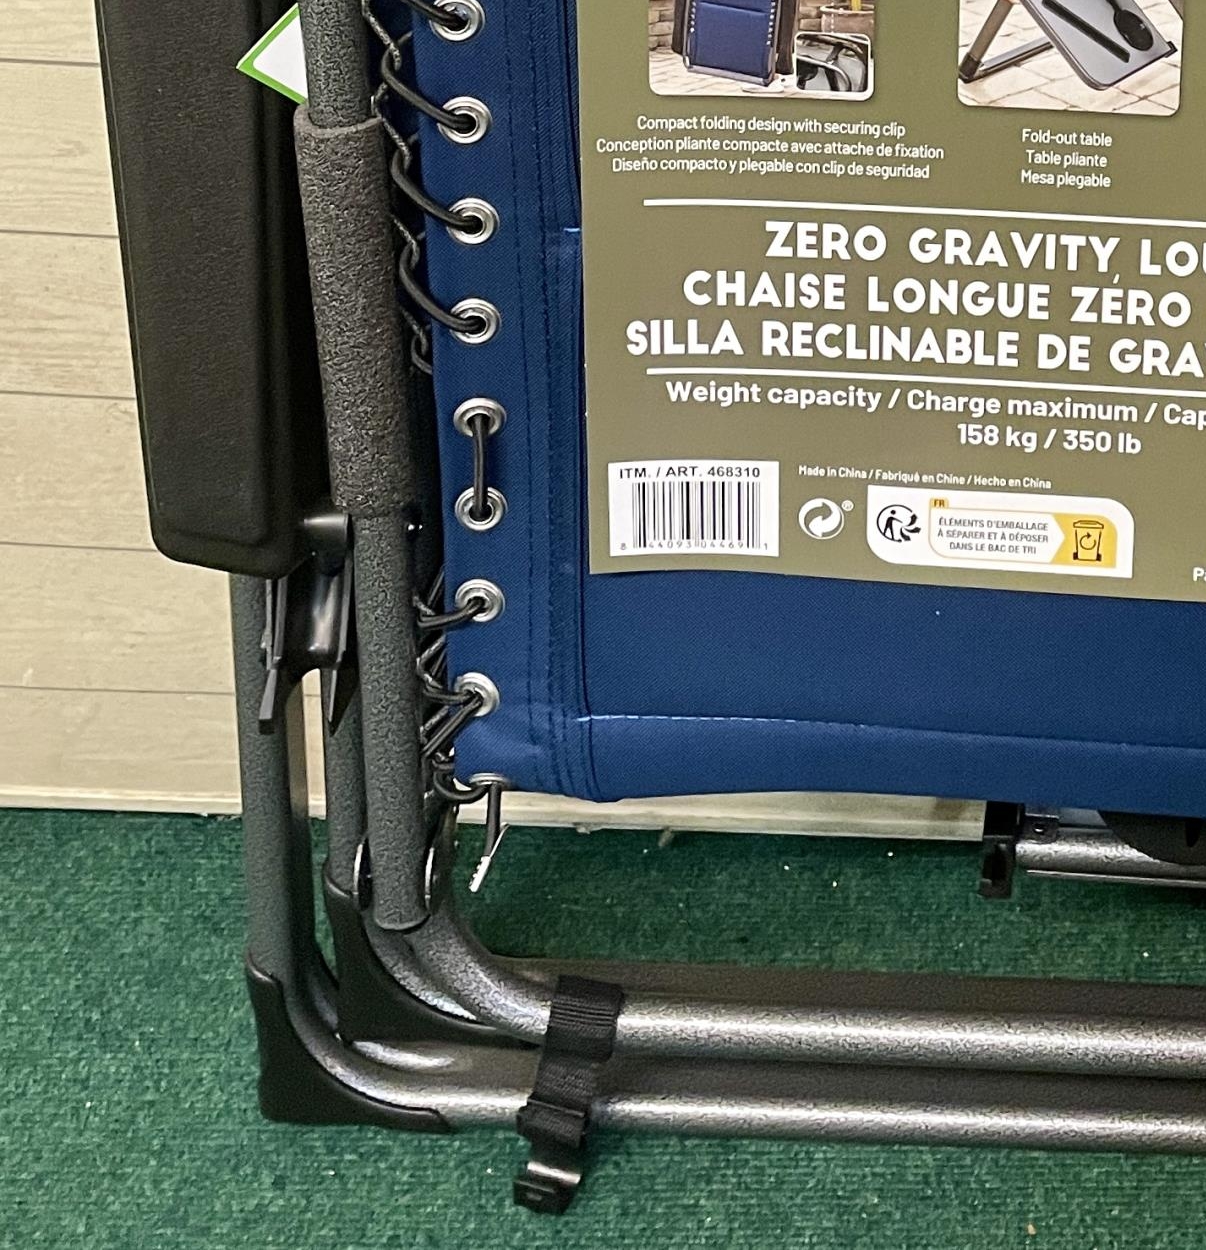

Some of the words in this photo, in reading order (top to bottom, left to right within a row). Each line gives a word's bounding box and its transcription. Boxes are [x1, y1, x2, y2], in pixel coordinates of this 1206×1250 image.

[637, 115, 698, 132] Compact
[700, 115, 746, 134] folding
[747, 116, 792, 135] design
[793, 118, 823, 134] with
[824, 120, 880, 139] securing
[882, 121, 906, 140] clip
[1022, 128, 1078, 145] Fold-out
[1079, 132, 1113, 147] table
[596, 136, 674, 154] Conception
[675, 136, 721, 154] pliante
[722, 138, 789, 155] compacte
[790, 142, 823, 154] avec
[824, 141, 874, 156] attache
[876, 142, 893, 157] de
[894, 143, 945, 159] fixation
[1025, 149, 1062, 165] Table
[1063, 151, 1108, 169] pliante
[612, 157, 658, 172] Diseño
[660, 157, 728, 174] compacto
[728, 160, 737, 174] y
[739, 157, 794, 175] plegable
[795, 162, 820, 174] con
[822, 160, 846, 178] clip
[847, 161, 864, 176] de
[865, 163, 930, 180] seguridad
[1021, 169, 1055, 185] Mesa
[1056, 171, 1112, 190] plegable
[764, 220, 888, 261] ZERO
[908, 226, 1121, 273] GRAVITY
[682, 269, 847, 311] CHAISE
[867, 275, 1051, 320] LONGUE
[1069, 273, 1193, 328] ZÉRO
[625, 317, 745, 357] SILLA
[760, 319, 1021, 369] RECLINABLE
[1036, 333, 1092, 372] DE
[665, 380, 762, 408] Weight
[767, 385, 883, 414] capacity
[887, 388, 901, 410] /
[906, 388, 1002, 419] Charge
[1007, 396, 1139, 423] maximum
[1143, 401, 1159, 425] /
[957, 423, 1000, 447] 158
[1004, 426, 1039, 453] kg
[1042, 427, 1056, 450] /
[1062, 429, 1113, 453] 350
[1117, 431, 1143, 455] lb
[619, 467, 651, 479] ITM.
[656, 466, 662, 478] /
[665, 465, 703, 478] ART.
[707, 466, 761, 478] 468310
[798, 464, 825, 477] Made
[826, 466, 837, 477] in
[838, 466, 867, 479] China
[868, 469, 874, 480] /
[875, 468, 921, 484] Fabriqué
[921, 474, 935, 484] en
[936, 473, 966, 485] Chine
[966, 475, 973, 486] /
[973, 474, 1007, 487] Hecho
[1008, 478, 1021, 488] en
[1022, 476, 1052, 489] China
[933, 498, 946, 508] FR
[987, 531, 998, 540] ET
[949, 541, 974, 551] DANS
[975, 543, 985, 552] LE
[987, 544, 1006, 553] BAC
[1008, 545, 1021, 553] DE
[1022, 545, 1037, 555] TRI
